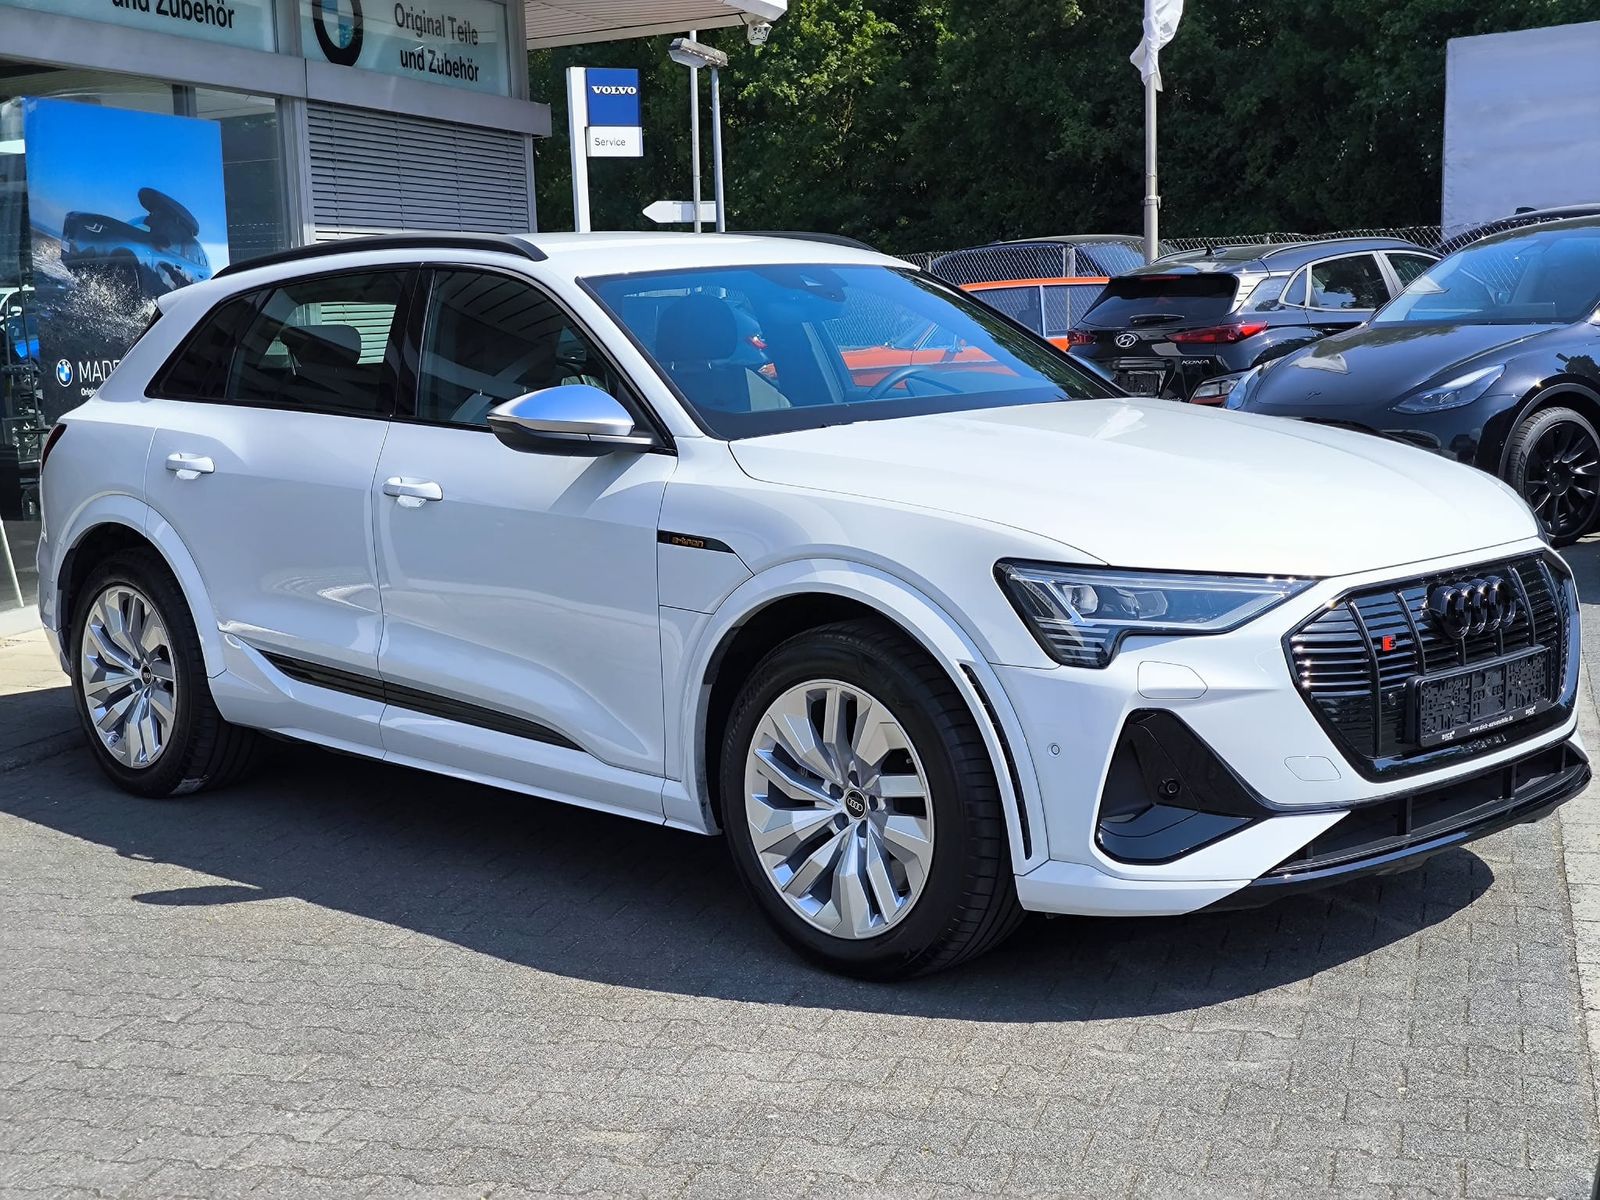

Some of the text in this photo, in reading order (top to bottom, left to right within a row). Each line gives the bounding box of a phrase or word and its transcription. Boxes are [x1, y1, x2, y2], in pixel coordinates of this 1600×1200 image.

[155, 0, 235, 29] Zubehör
[394, 3, 479, 45] Original Teile
[400, 47, 480, 82] und Zubehör
[591, 85, 637, 95] VOLVO
[594, 137, 626, 147] Service
[672, 537, 704, 548] e-tron
